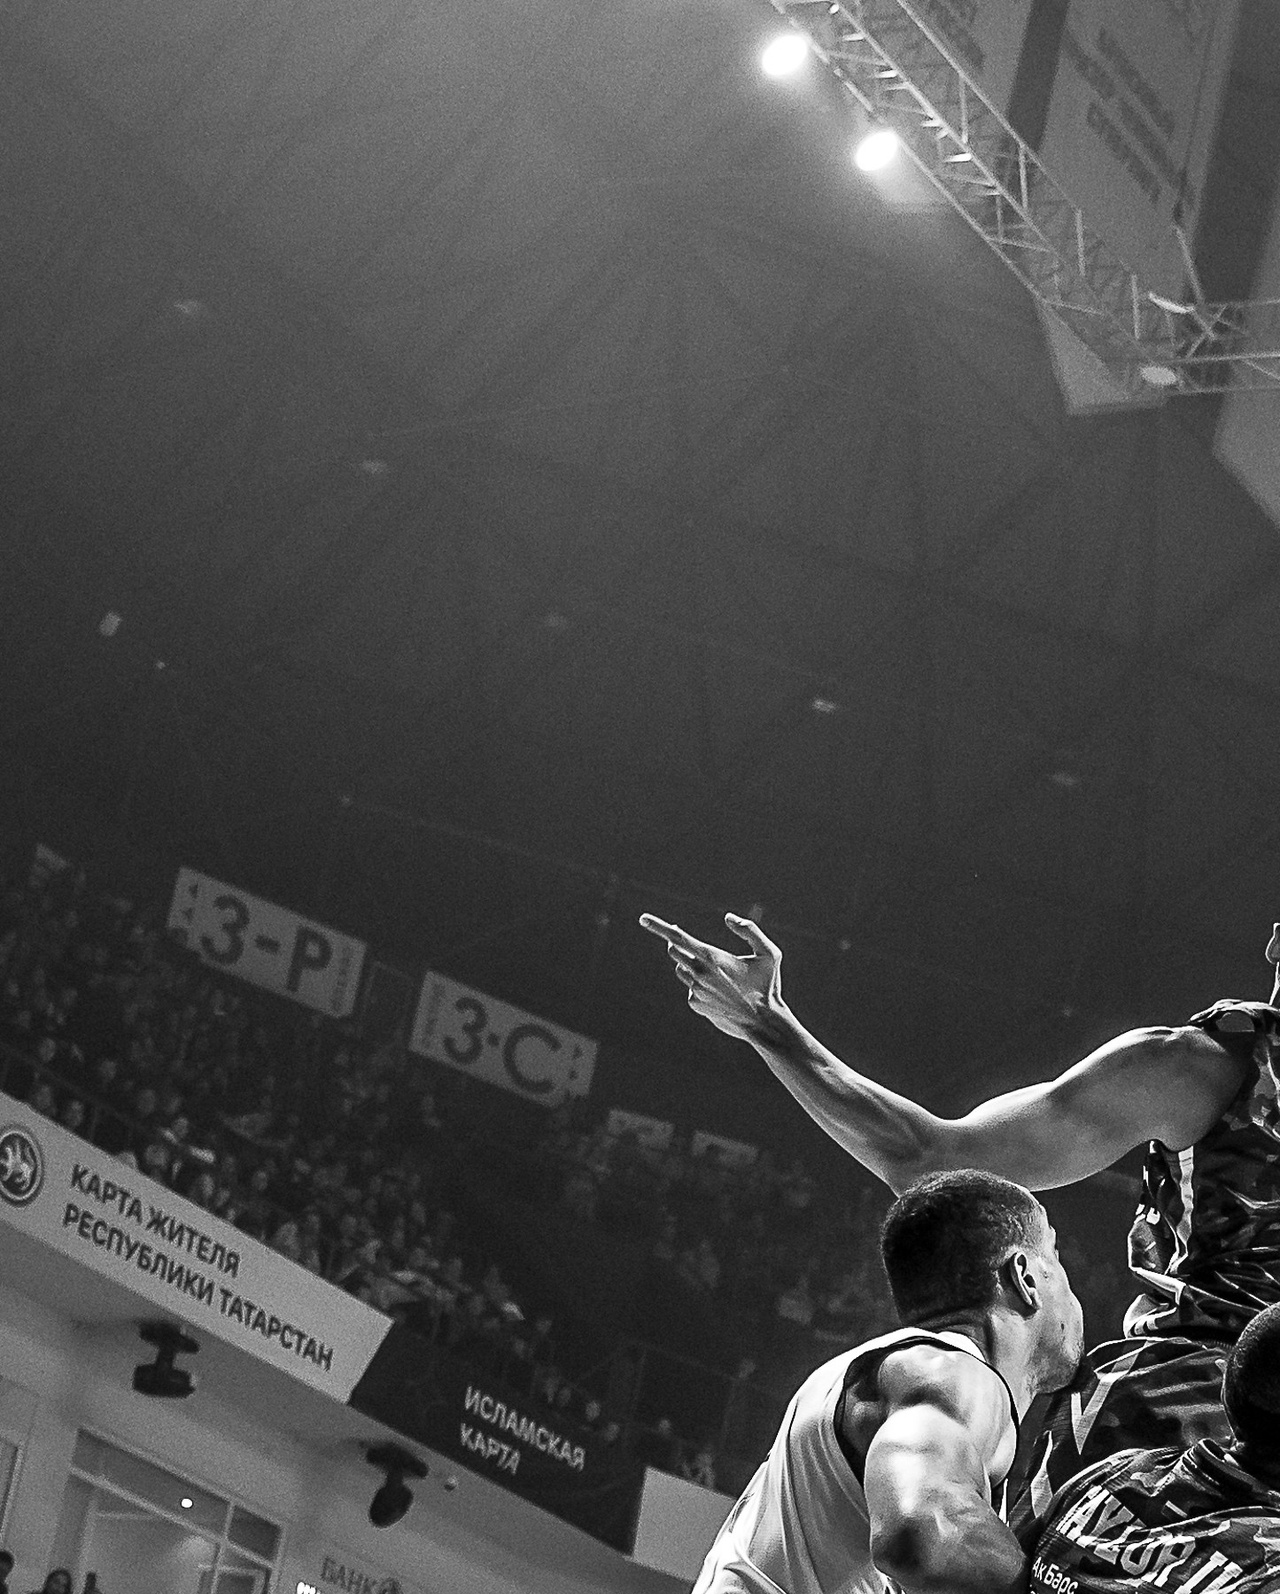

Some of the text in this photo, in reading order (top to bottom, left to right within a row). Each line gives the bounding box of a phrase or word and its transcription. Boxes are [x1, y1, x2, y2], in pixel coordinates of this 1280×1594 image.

[70, 1163, 241, 1279] КАРТА ЖИТЕЛЯ
[63, 1202, 334, 1372] РЕСПУБЛИКИ ТАТАРСТАН
[460, 1422, 521, 1476] КАРТА
[464, 1385, 586, 1472] ИСЛАМСКАЯ
